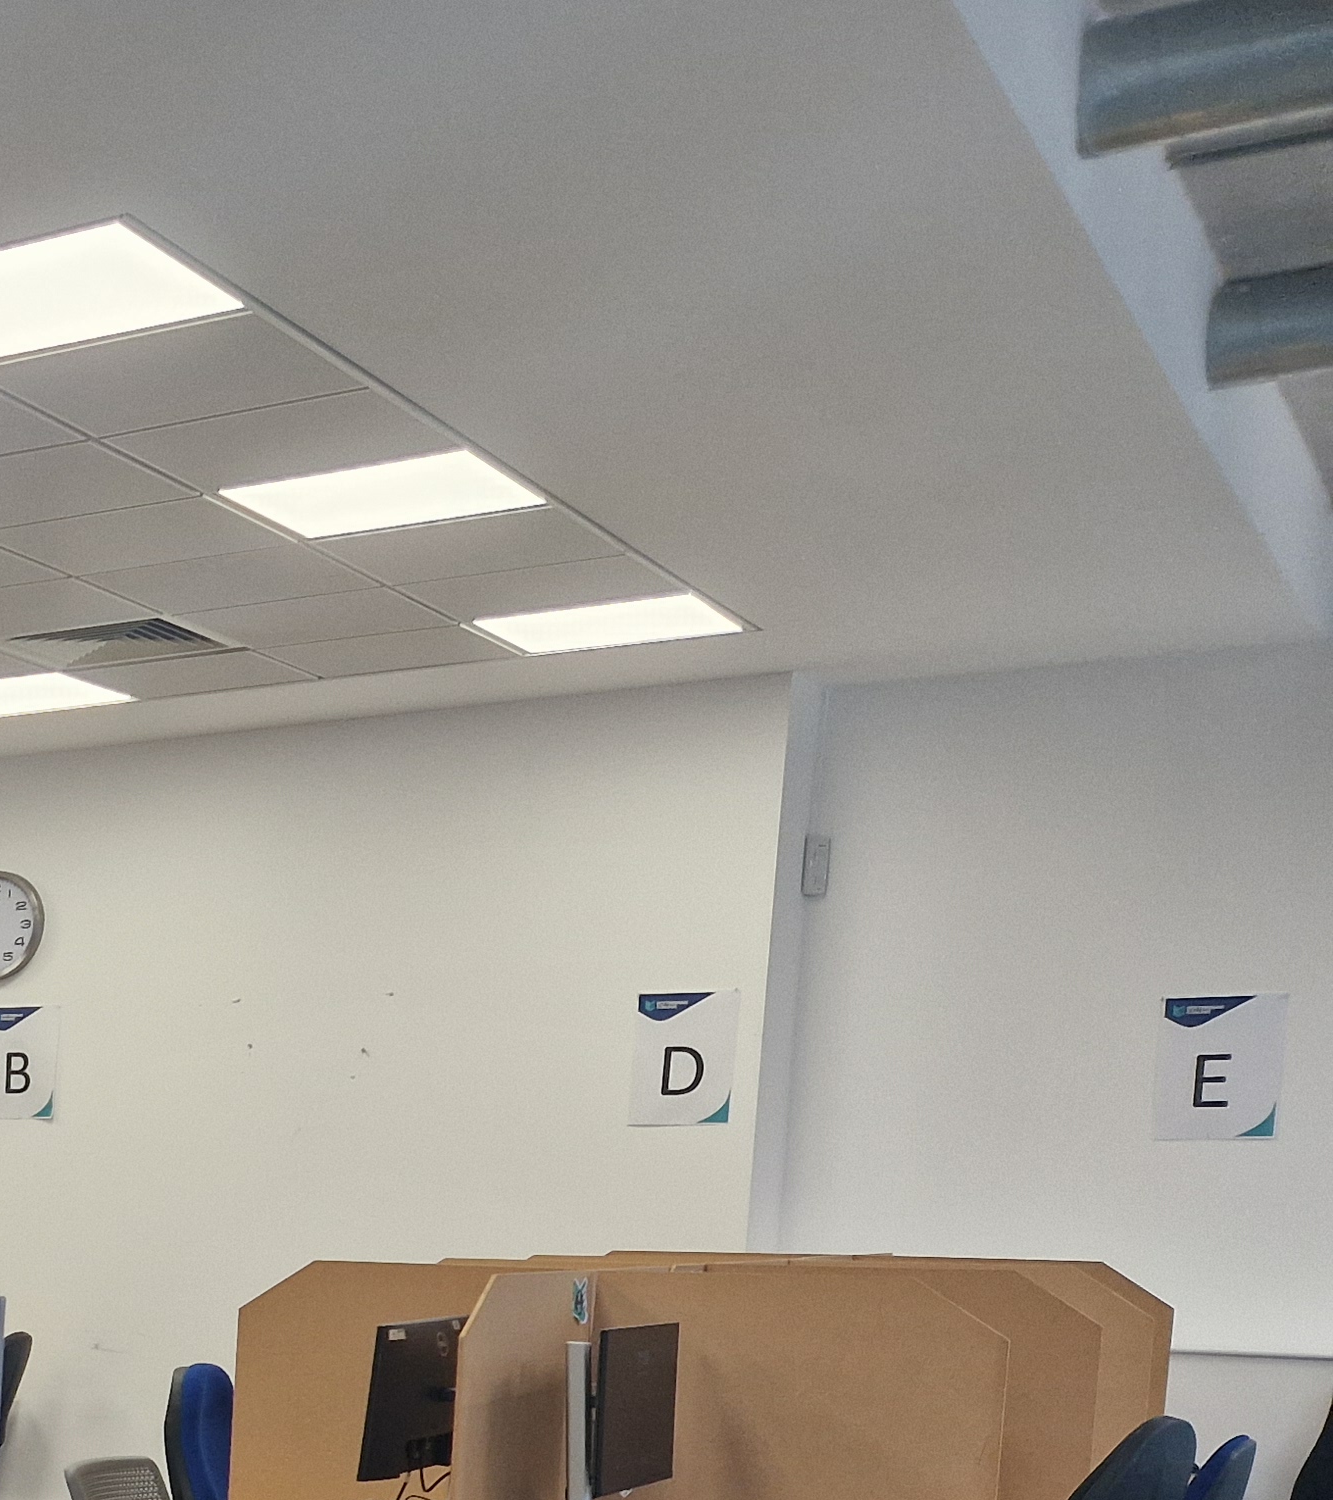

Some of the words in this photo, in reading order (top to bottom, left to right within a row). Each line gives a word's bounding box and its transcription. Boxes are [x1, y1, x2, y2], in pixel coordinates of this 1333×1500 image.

[15, 901, 28, 911] 2
[20, 919, 32, 929] 3
[14, 936, 25, 947] 4
[3, 952, 14, 961] 5
[5, 1052, 31, 1094] B
[661, 1046, 704, 1096] D
[1193, 1053, 1232, 1107] E
